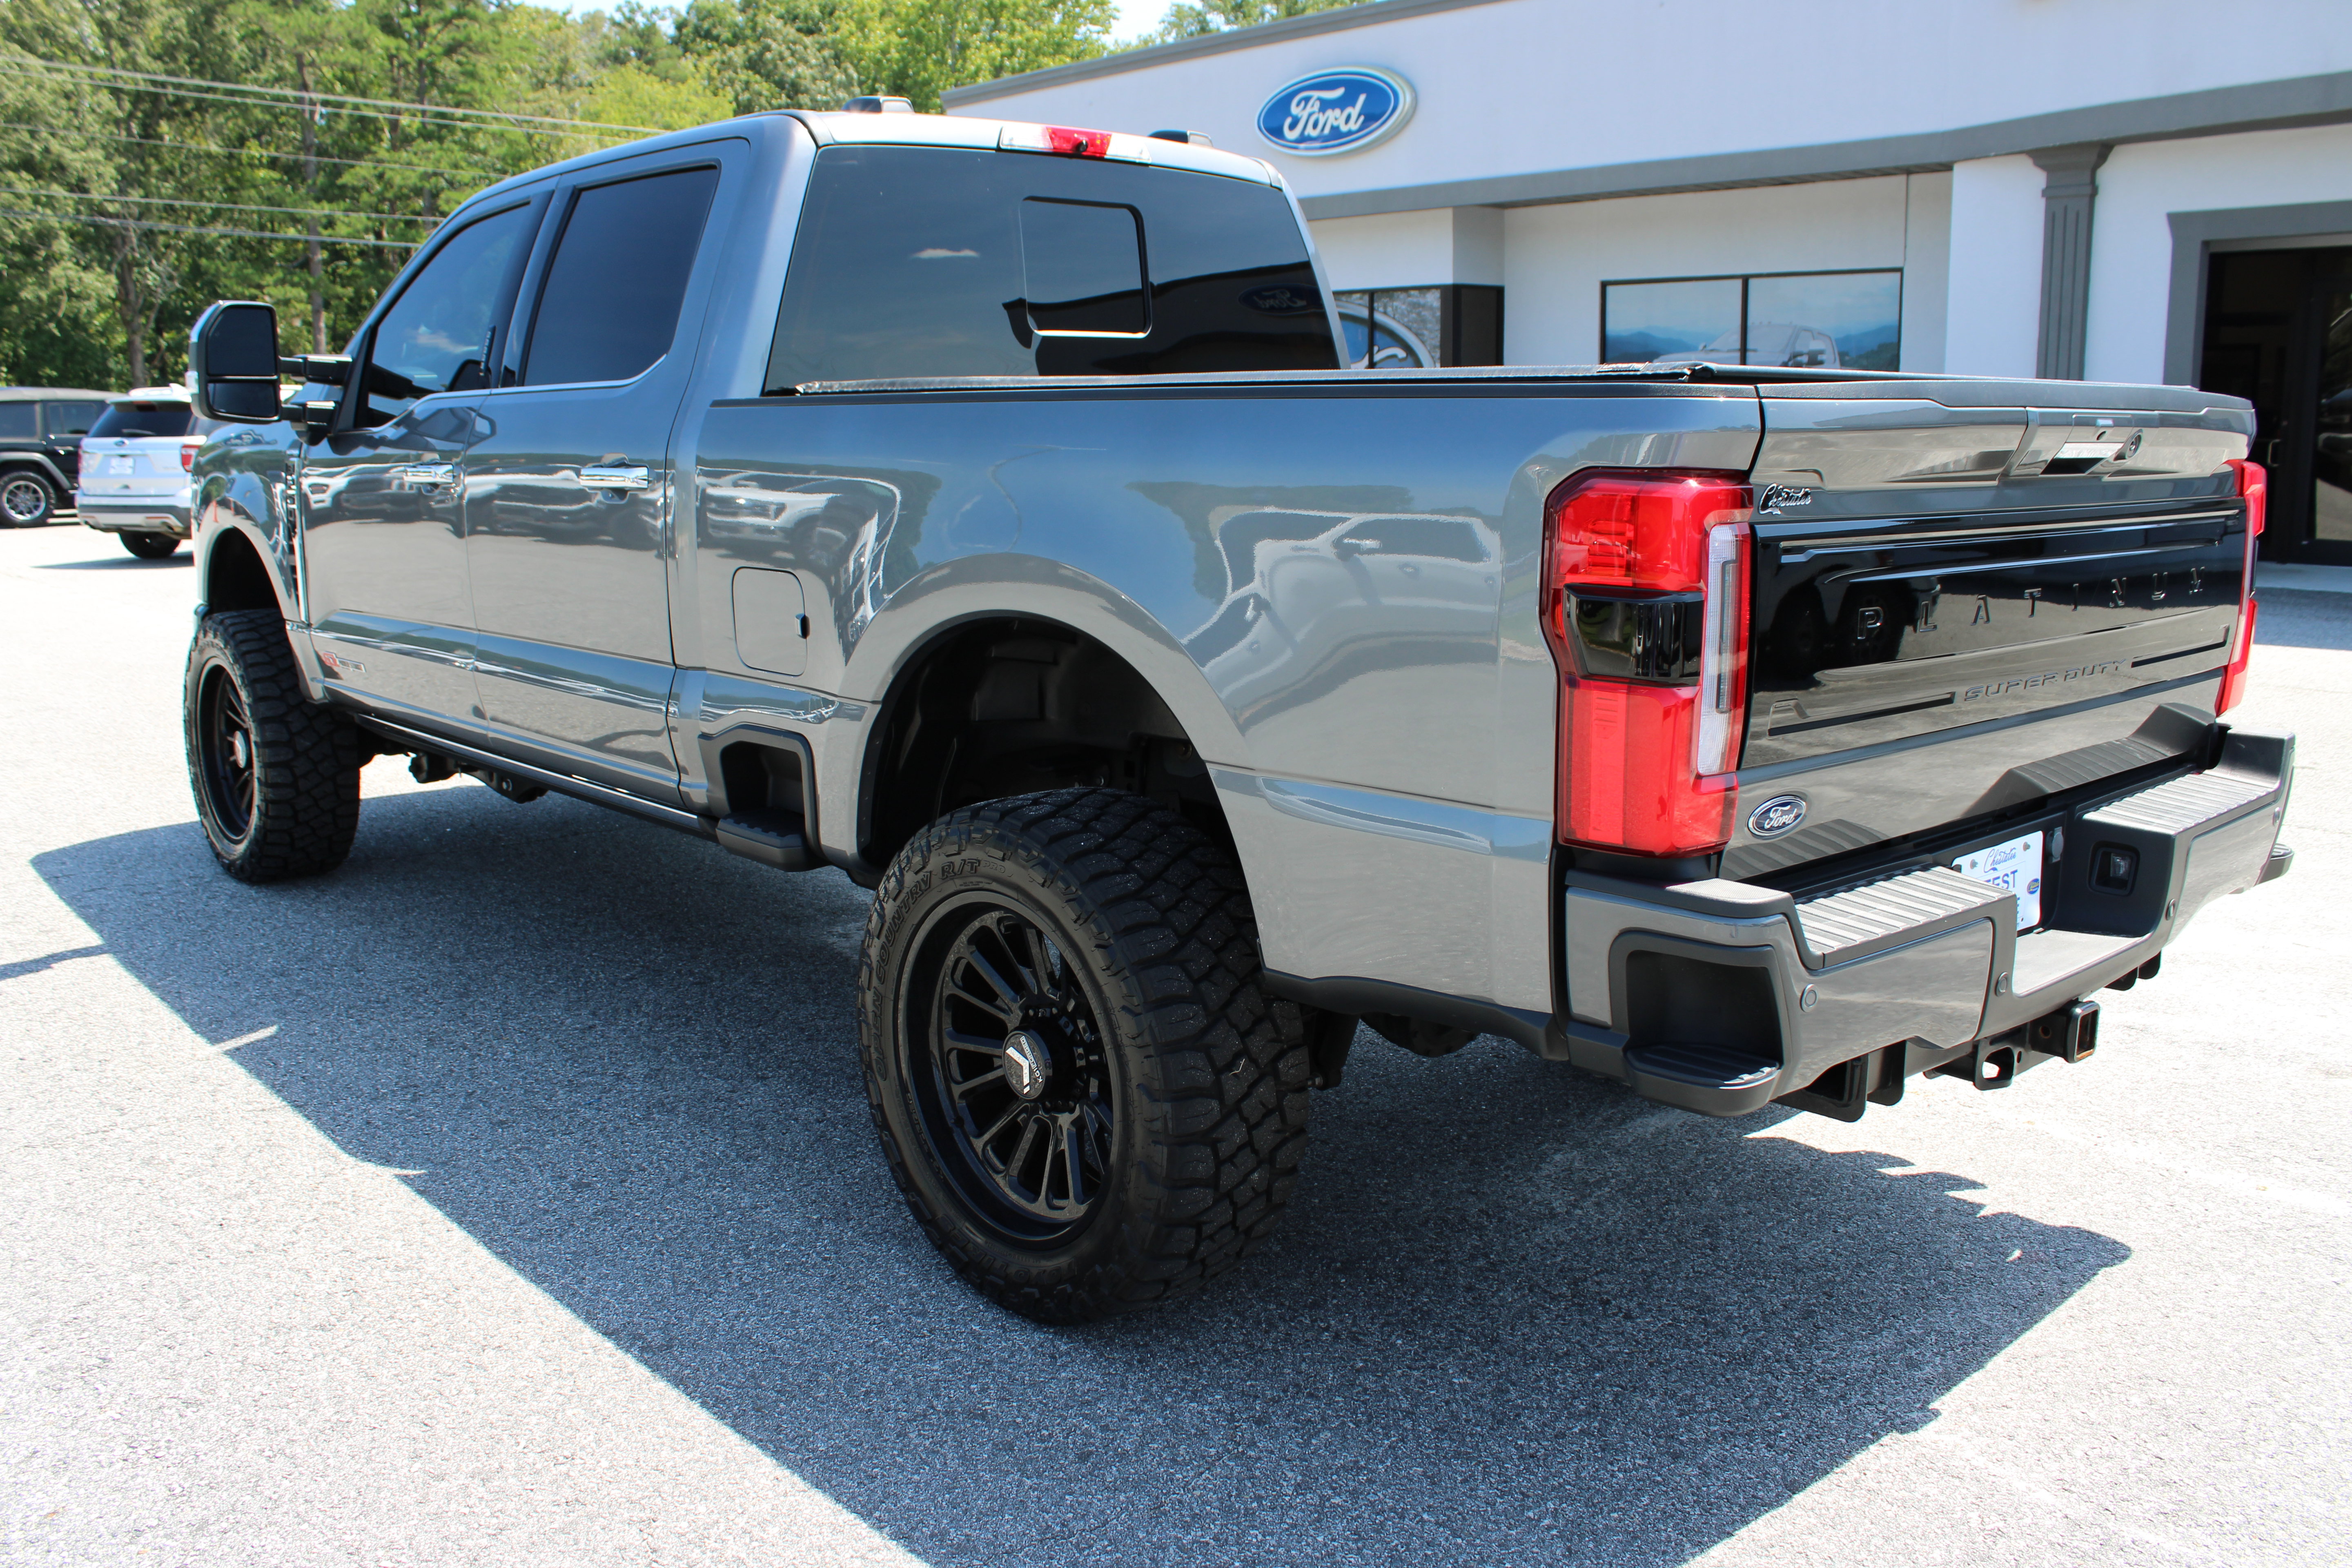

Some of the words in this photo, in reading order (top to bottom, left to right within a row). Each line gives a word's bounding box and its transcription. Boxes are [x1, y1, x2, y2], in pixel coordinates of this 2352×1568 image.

[1283, 86, 1367, 140] Ford
[1857, 566, 2205, 640] PLATINUM
[1964, 671, 2058, 702] SUPER
[2063, 658, 2127, 682] DUTY
[1764, 805, 1797, 829] Ford
[940, 858, 980, 880] R/T
[982, 860, 1006, 874] PRO
[1983, 847, 2016, 873] Chestatee
[875, 870, 931, 985] COUNTRY
[872, 986, 886, 1081] OPEN
